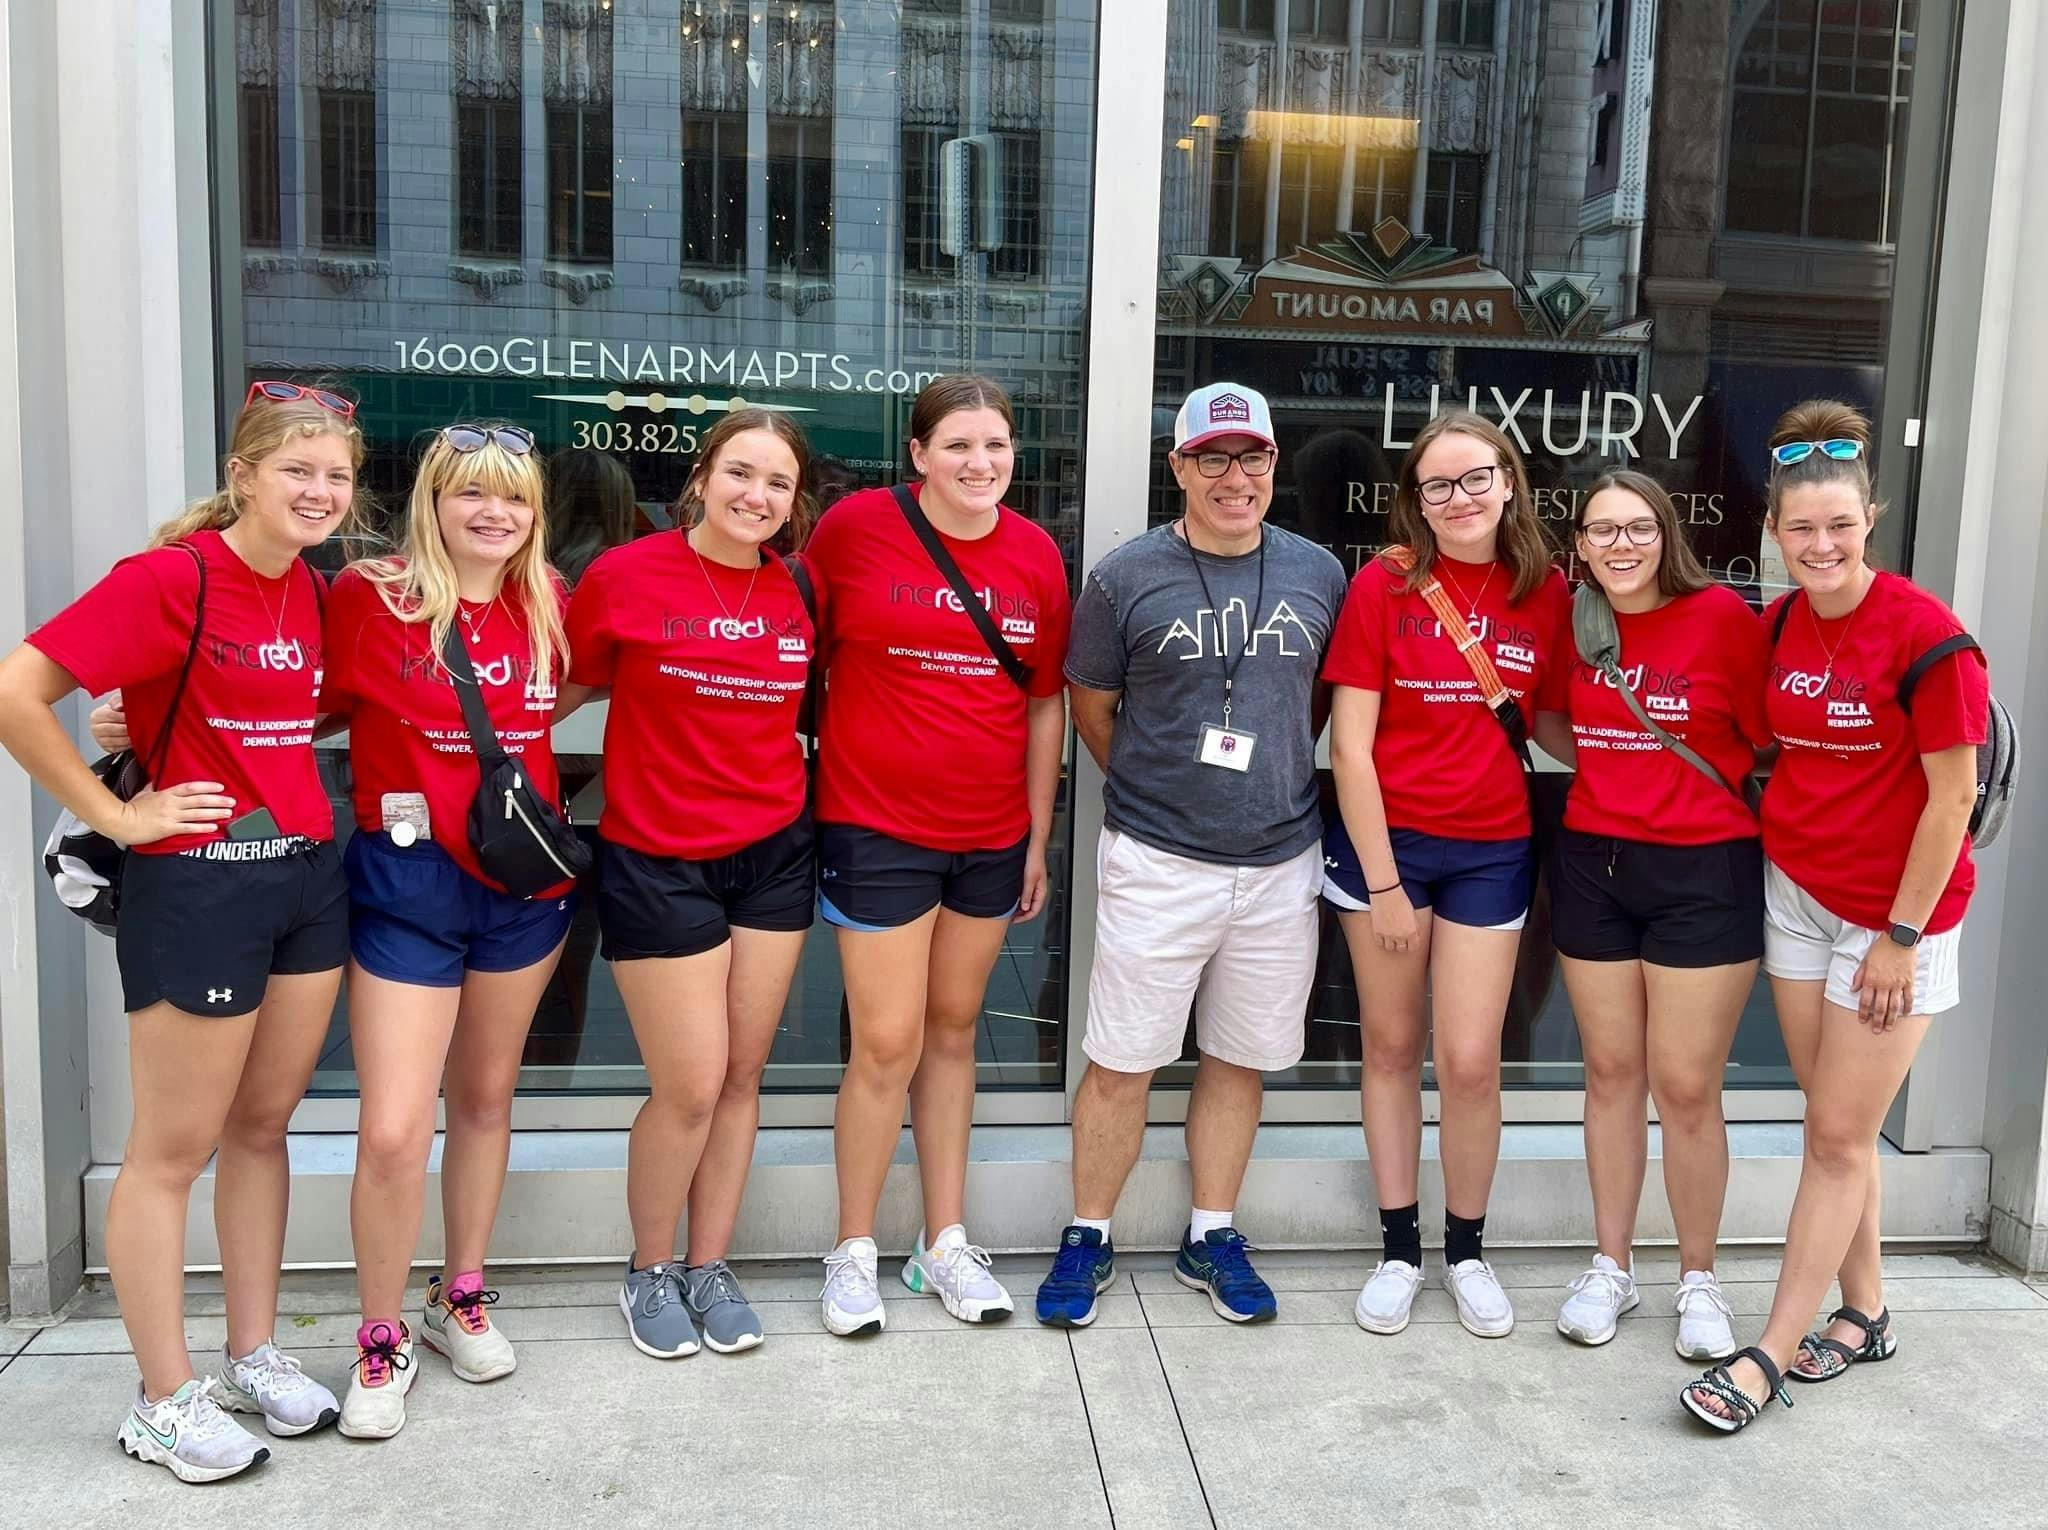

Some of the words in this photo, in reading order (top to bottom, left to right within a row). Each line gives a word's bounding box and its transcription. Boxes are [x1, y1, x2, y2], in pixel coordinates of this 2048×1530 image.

[572, 420, 713, 454] 303.825.
[887, 646, 934, 661] NATIONAL
[934, 652, 982, 664] LEADERSHIP
[659, 664, 710, 683] NATIONAL
[711, 673, 766, 690] LEADERSHIP
[737, 691, 785, 703] COLORADO
[1827, 718, 1875, 728] NEBRASKA
[1588, 726, 1638, 739] LEADERSHIP
[1611, 741, 1663, 752] COLORADO
